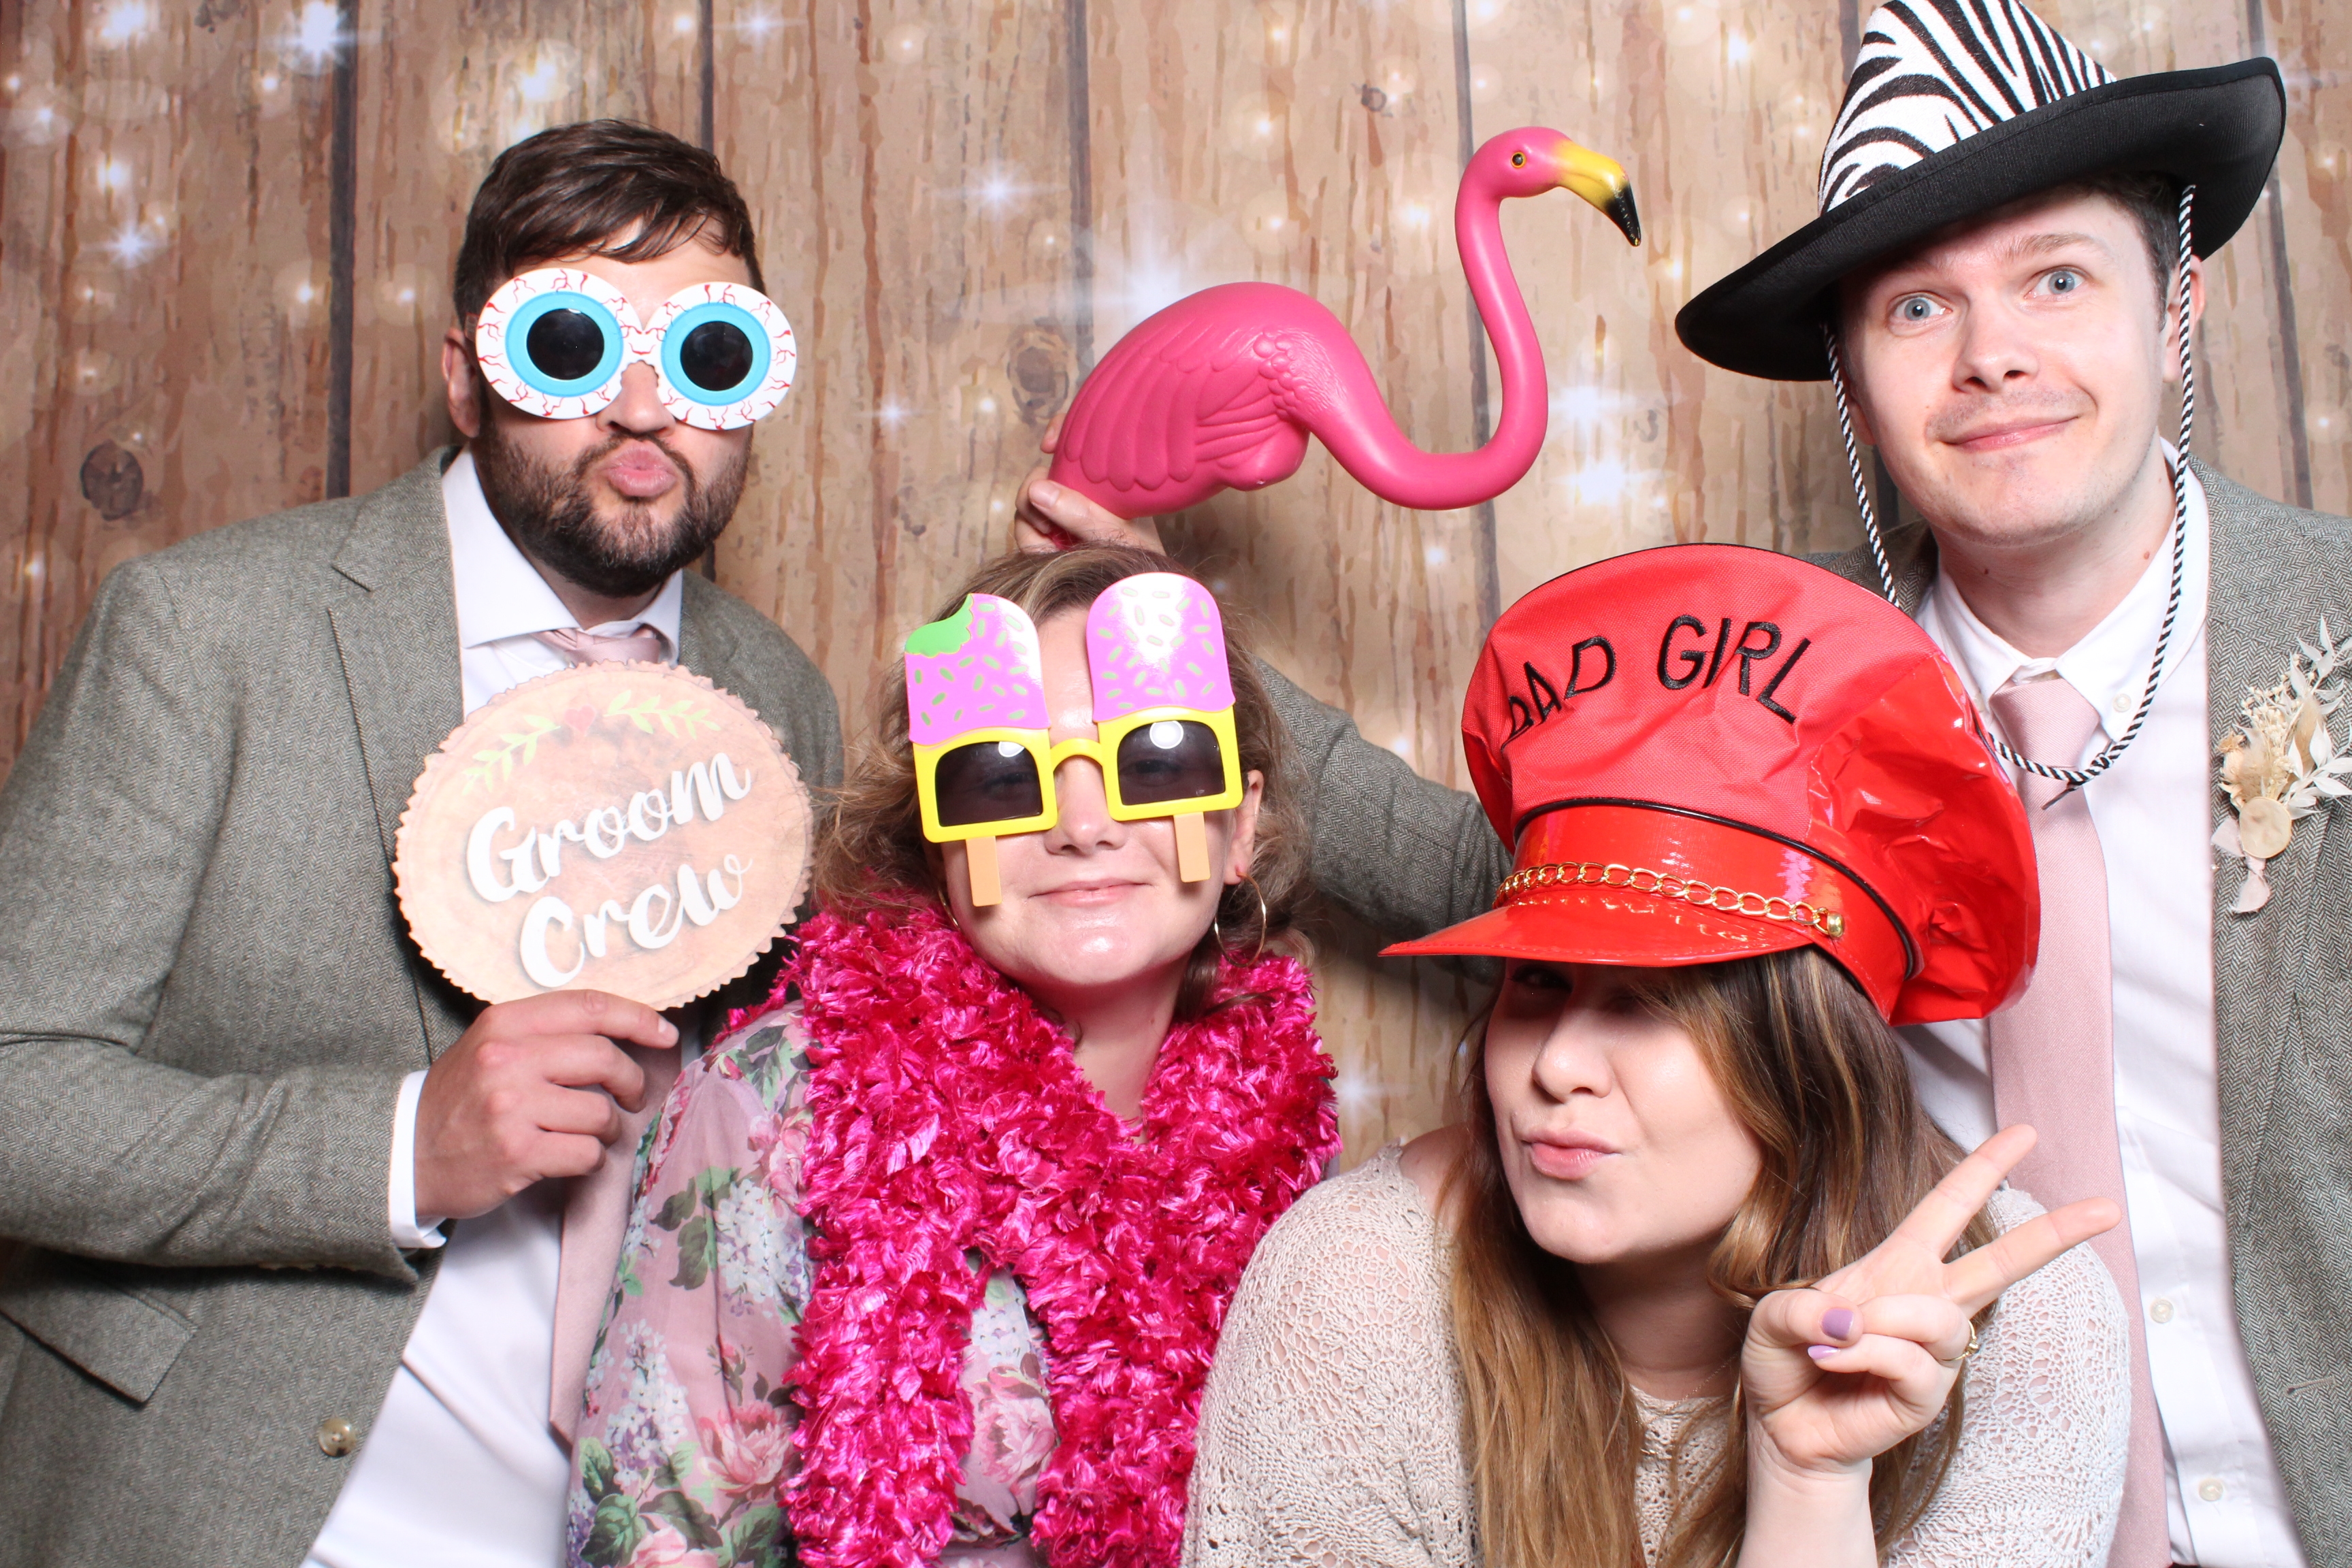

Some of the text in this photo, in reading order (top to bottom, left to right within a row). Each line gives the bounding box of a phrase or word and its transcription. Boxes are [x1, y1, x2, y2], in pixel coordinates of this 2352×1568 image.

[1657, 614, 1812, 724] GIRL
[467, 752, 751, 902] Groom
[520, 853, 753, 987] Crew
